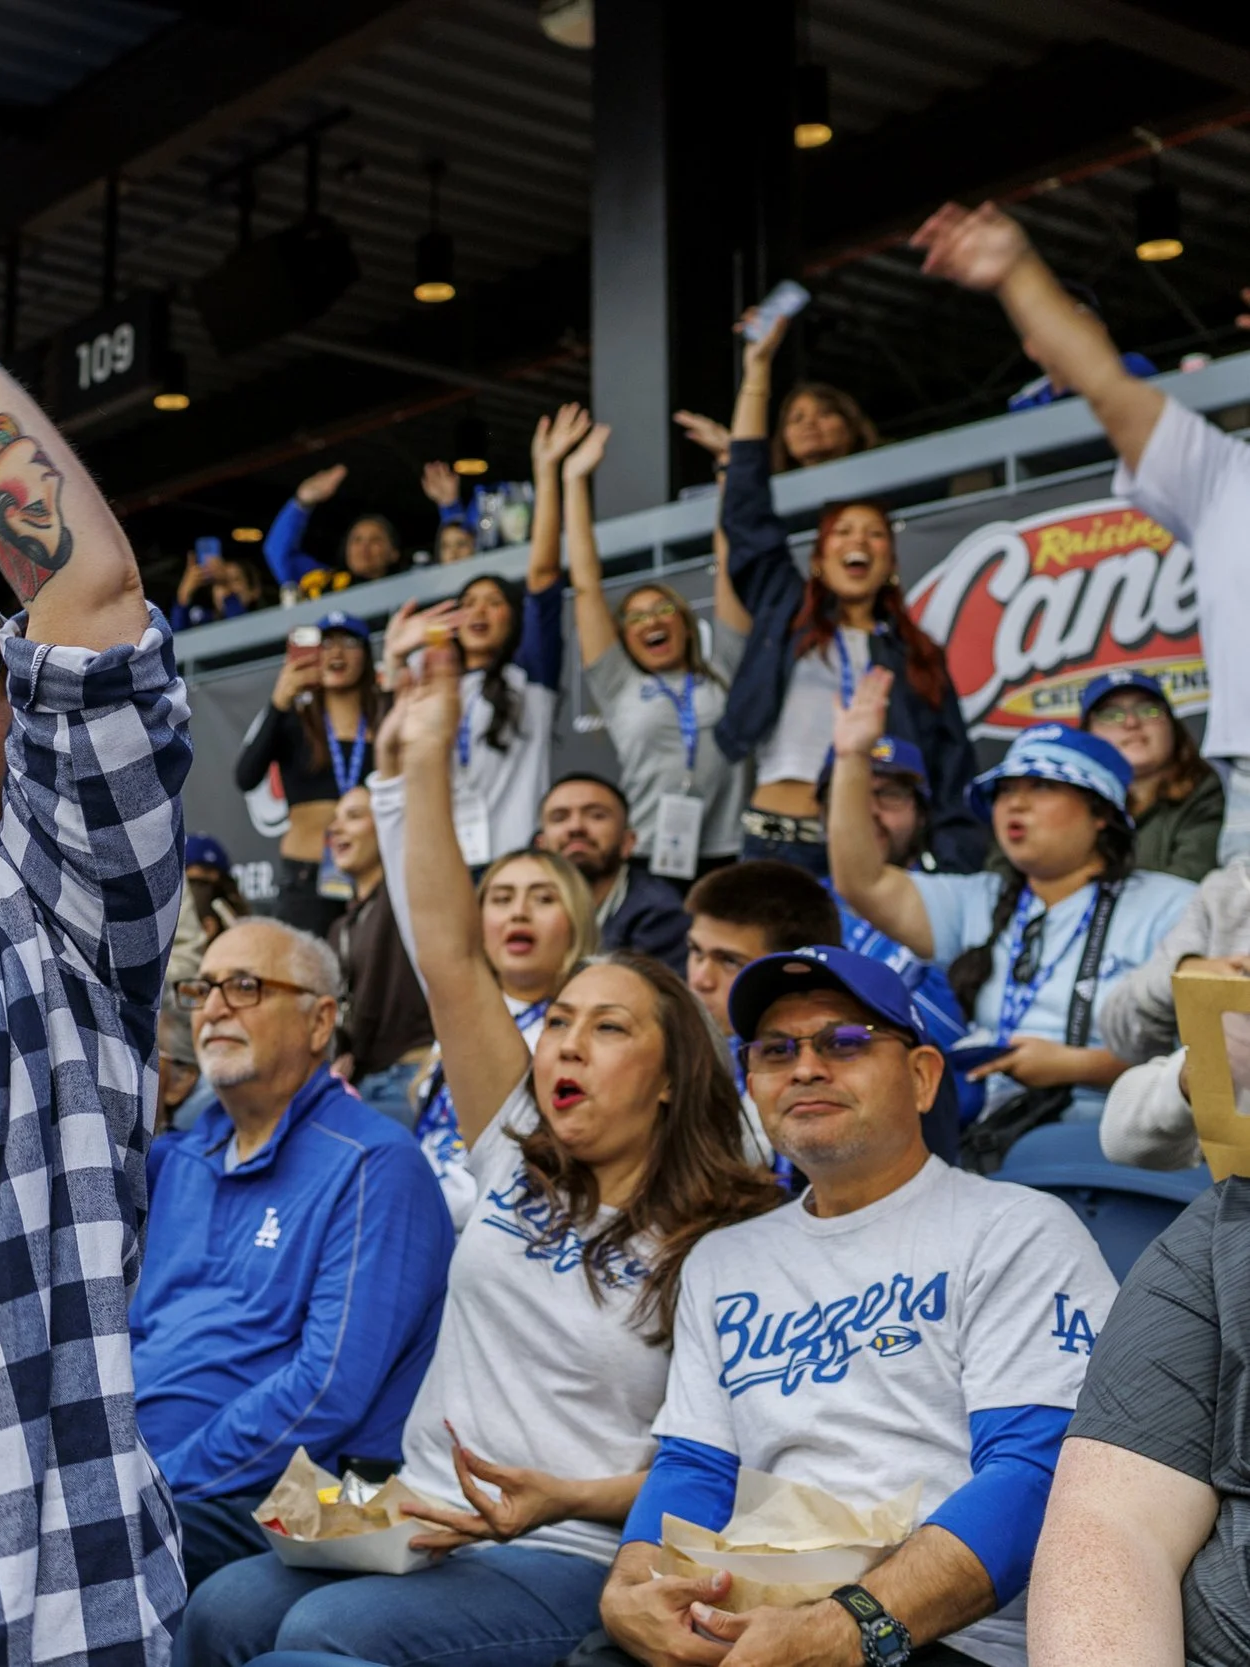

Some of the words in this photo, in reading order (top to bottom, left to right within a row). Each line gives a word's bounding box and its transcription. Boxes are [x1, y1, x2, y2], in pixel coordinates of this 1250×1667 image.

[76, 322, 135, 390] 109
[1033, 511, 1174, 572] Raising
[716, 1271, 949, 1396] Buzzers
[1051, 1292, 1100, 1356] LA
